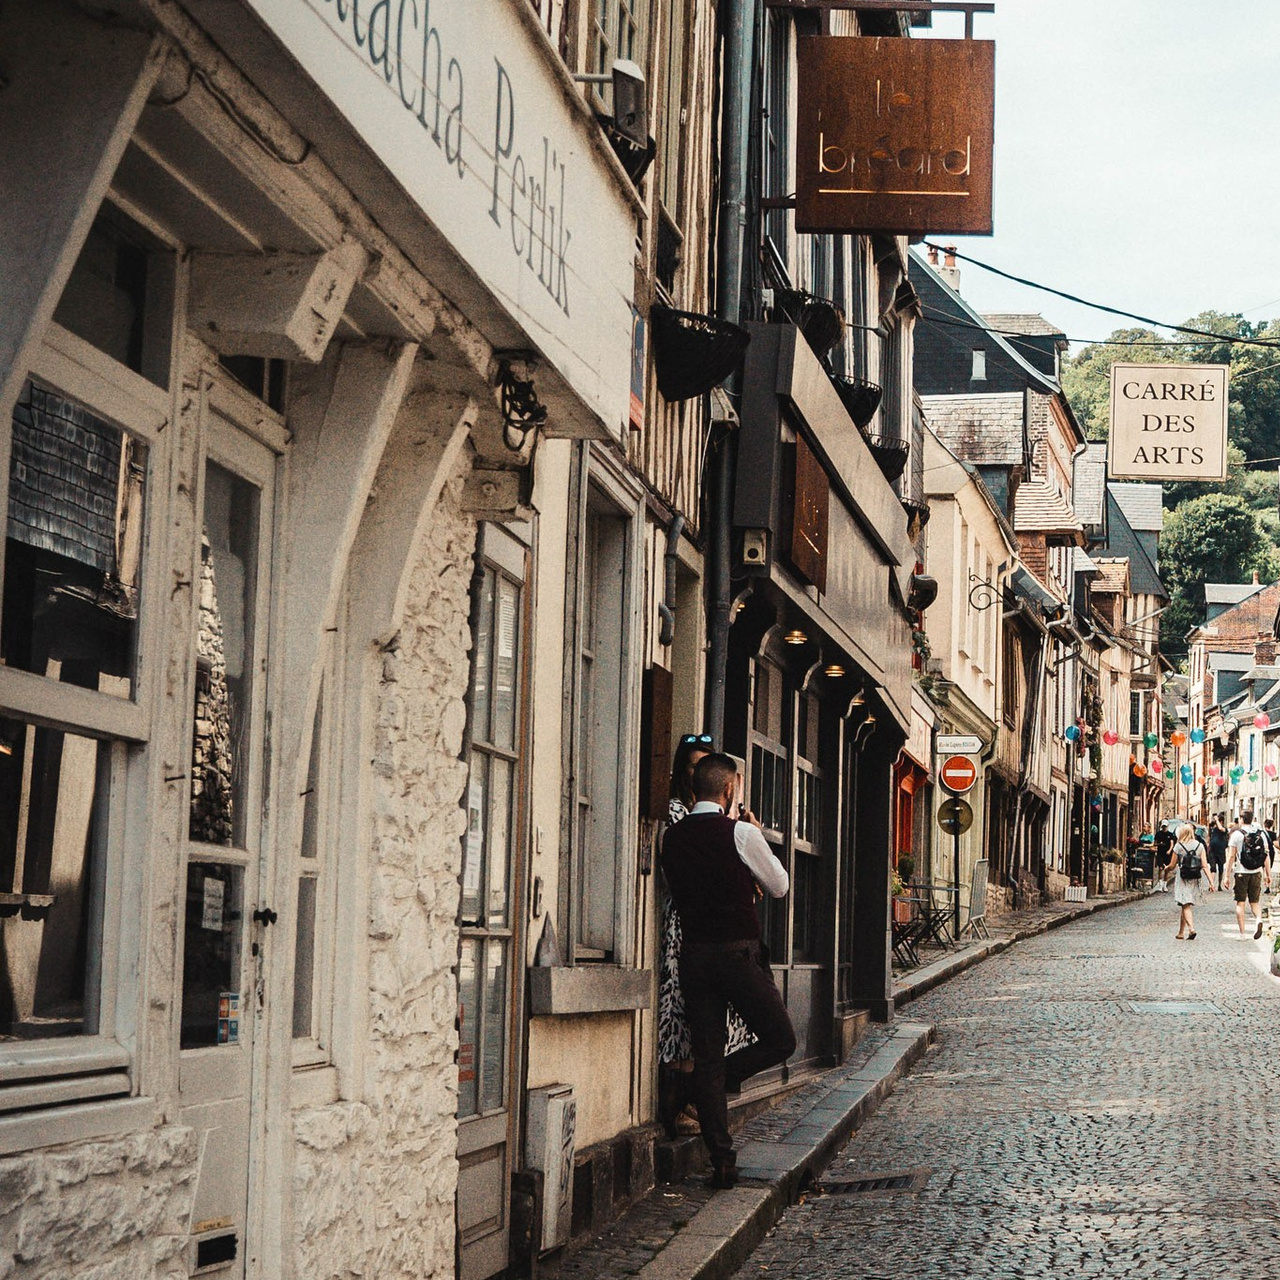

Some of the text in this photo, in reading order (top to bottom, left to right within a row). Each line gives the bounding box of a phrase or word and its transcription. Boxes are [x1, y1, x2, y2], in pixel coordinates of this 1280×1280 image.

[489, 55, 571, 319] Perlik
[1122, 379, 1215, 402] CARRÉ
[1141, 414, 1195, 433] DES
[1132, 446, 1204, 465] ARTS
